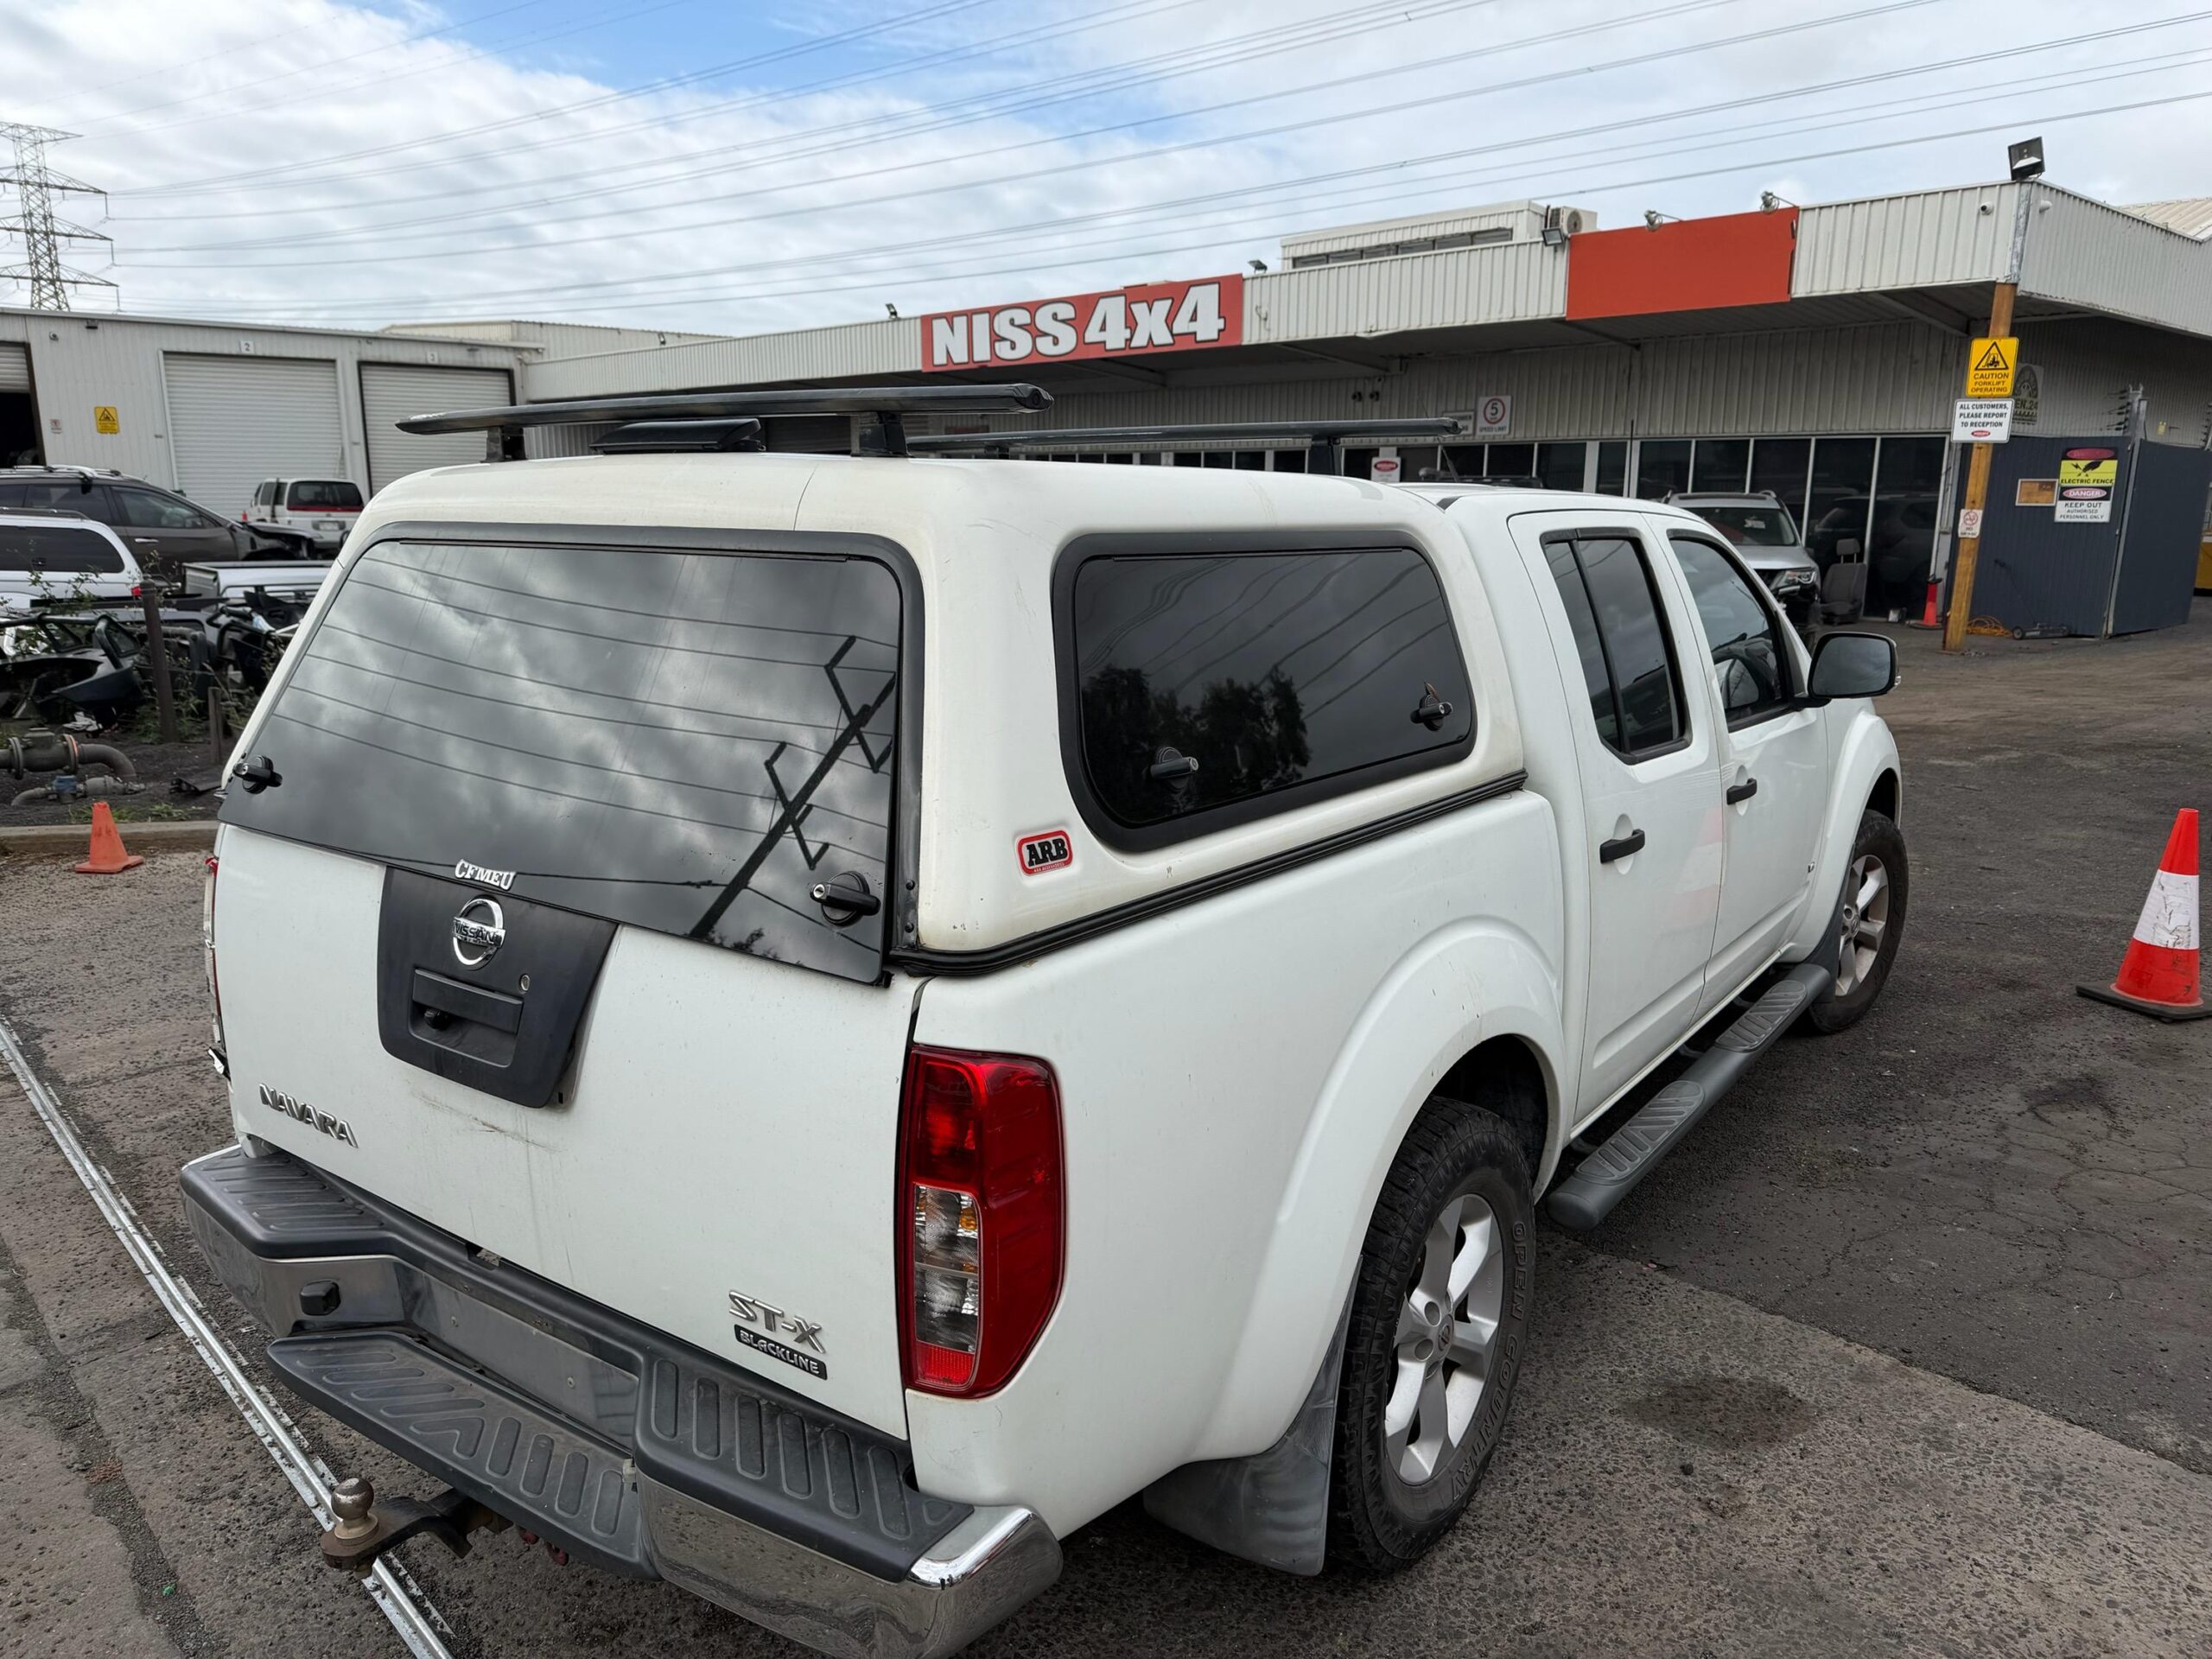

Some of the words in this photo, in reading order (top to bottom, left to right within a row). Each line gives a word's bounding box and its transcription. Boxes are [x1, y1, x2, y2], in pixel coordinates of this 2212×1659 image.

[245, 342, 251, 352] 2
[931, 301, 1077, 366] NISS
[1084, 282, 1226, 352] 4x4
[1490, 402, 1499, 416] 5
[454, 858, 518, 891] CFMEU
[1026, 837, 1069, 868] ARB
[454, 921, 503, 945] NISSAN
[259, 1082, 359, 1148] NAVARA
[1510, 1221, 1528, 1321] OPEN
[728, 1289, 826, 1355] ST-X
[740, 1329, 820, 1375] BLACKLINE
[1452, 1334, 1518, 1500] COUNTRY
